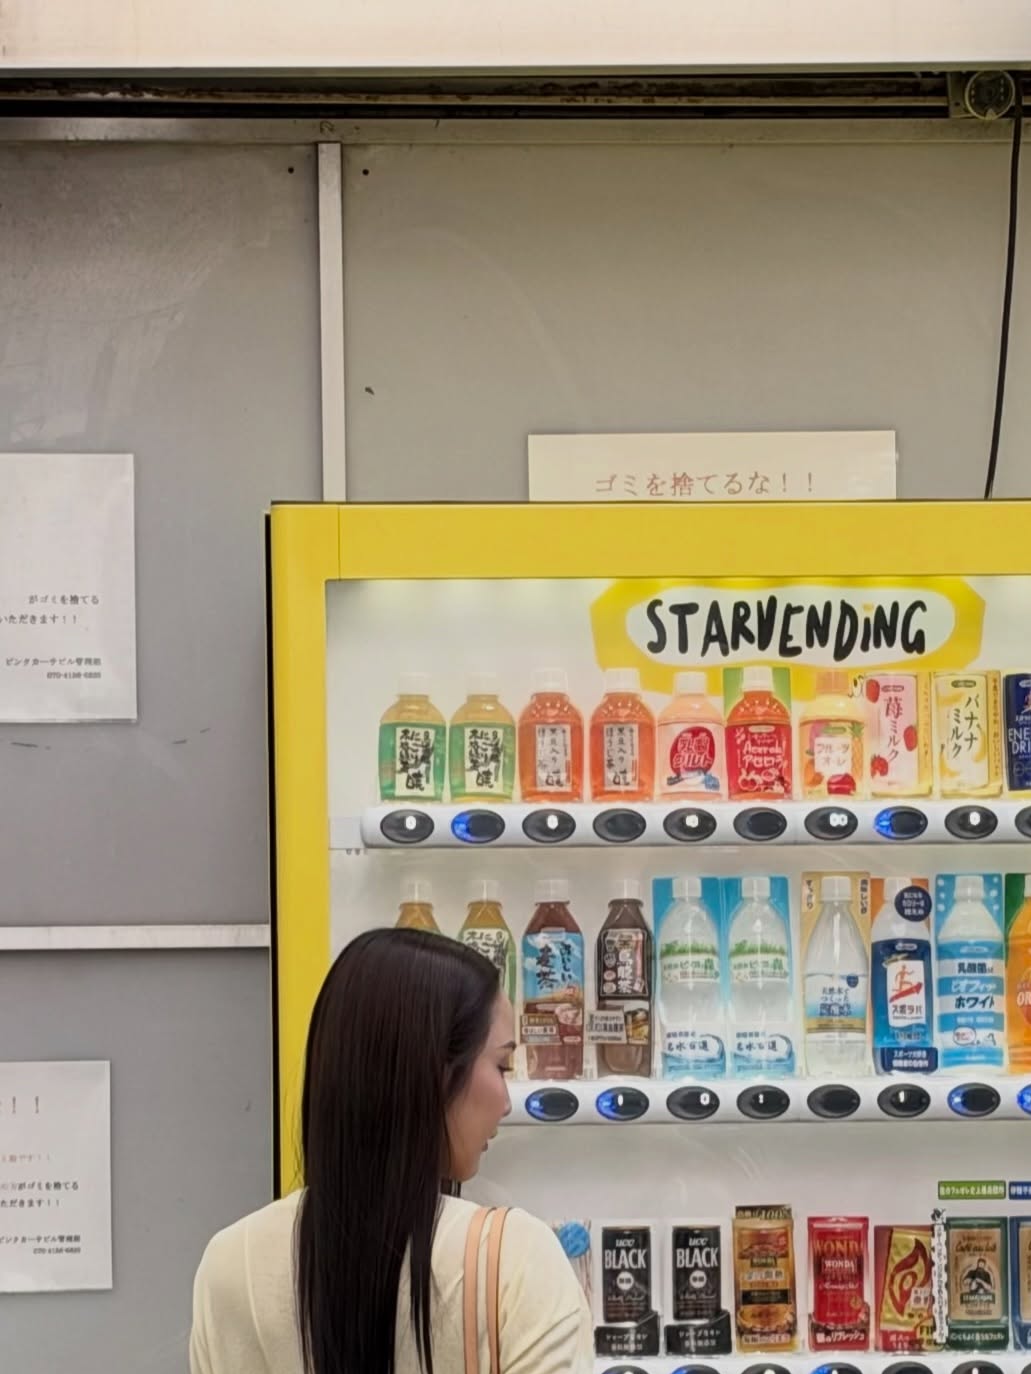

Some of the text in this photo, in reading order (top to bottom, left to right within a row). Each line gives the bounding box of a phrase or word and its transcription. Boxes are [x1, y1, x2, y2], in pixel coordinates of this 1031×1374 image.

[595, 470, 814, 497] ゴミを捨てるな！！
[951, 708, 963, 758] ミルク
[964, 695, 981, 750] バナナ
[536, 944, 558, 990] 麦茶
[605, 1248, 647, 1269] BLACK
[676, 1247, 718, 1268] BLACK
